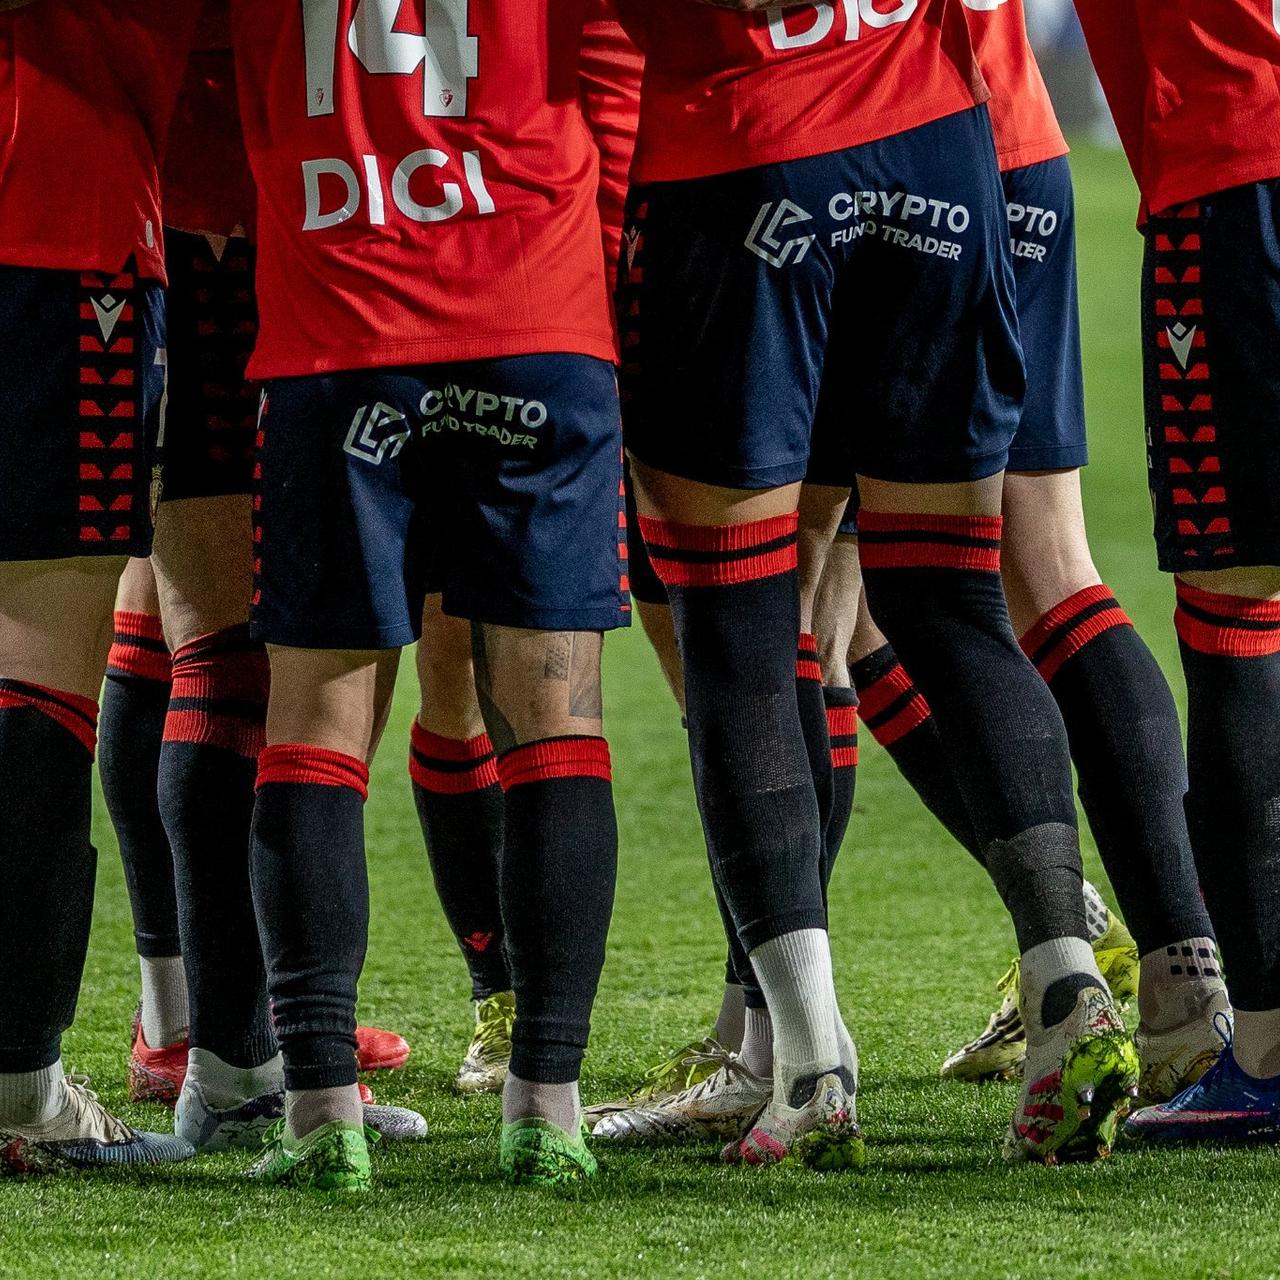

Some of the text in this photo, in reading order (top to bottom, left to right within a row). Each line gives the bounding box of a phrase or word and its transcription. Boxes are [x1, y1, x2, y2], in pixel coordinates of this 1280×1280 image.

[301, 148, 496, 231] DIGI
[828, 191, 970, 233] CRYPTO
[831, 220, 962, 261] FUND TRADER
